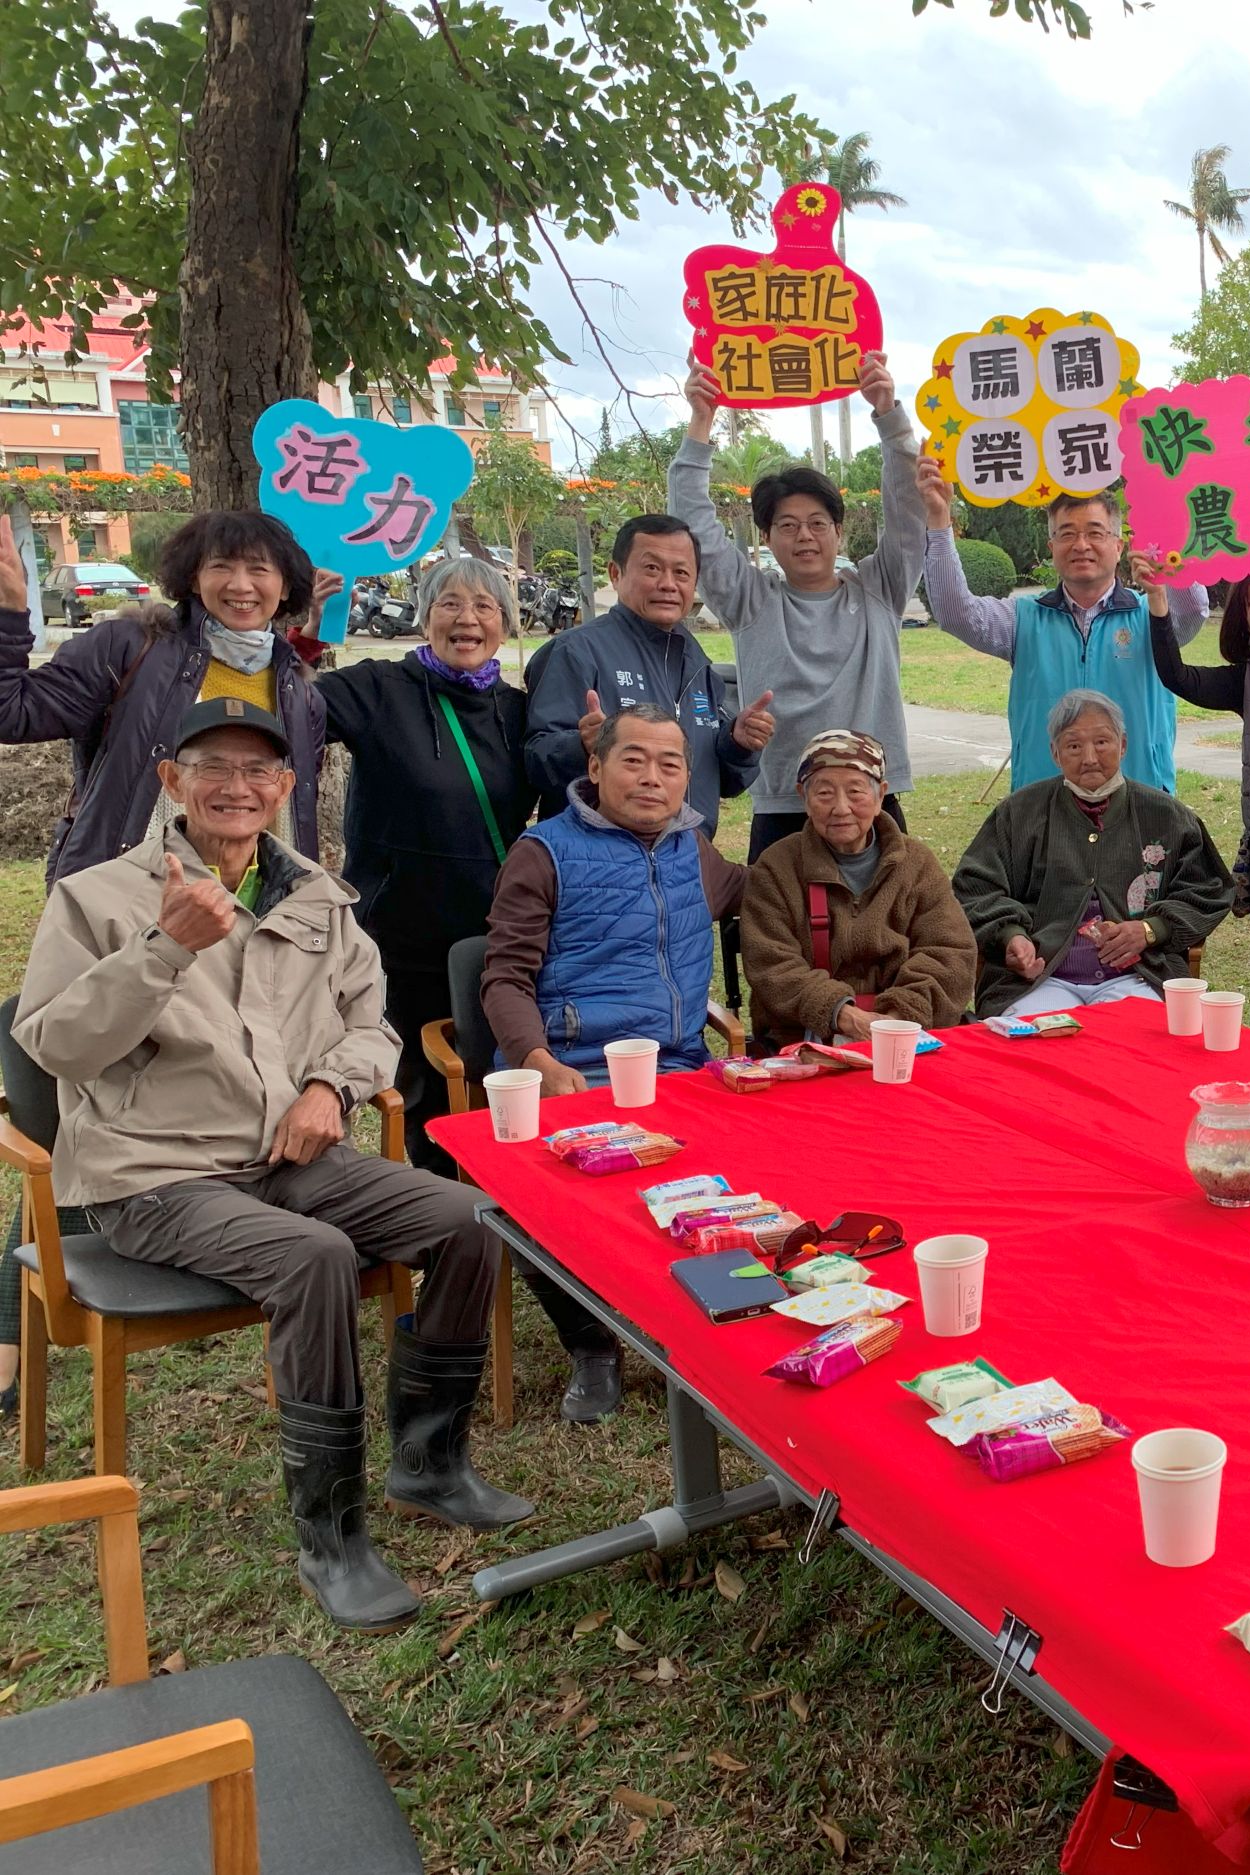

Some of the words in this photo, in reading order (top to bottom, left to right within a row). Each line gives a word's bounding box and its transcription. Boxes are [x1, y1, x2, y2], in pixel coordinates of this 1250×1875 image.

[711, 271, 853, 325] 家庭化
[717, 336, 861, 394] 社會化
[968, 337, 1104, 402] 馬蘭
[971, 421, 1112, 484] 榮家
[278, 429, 430, 552] 活力
